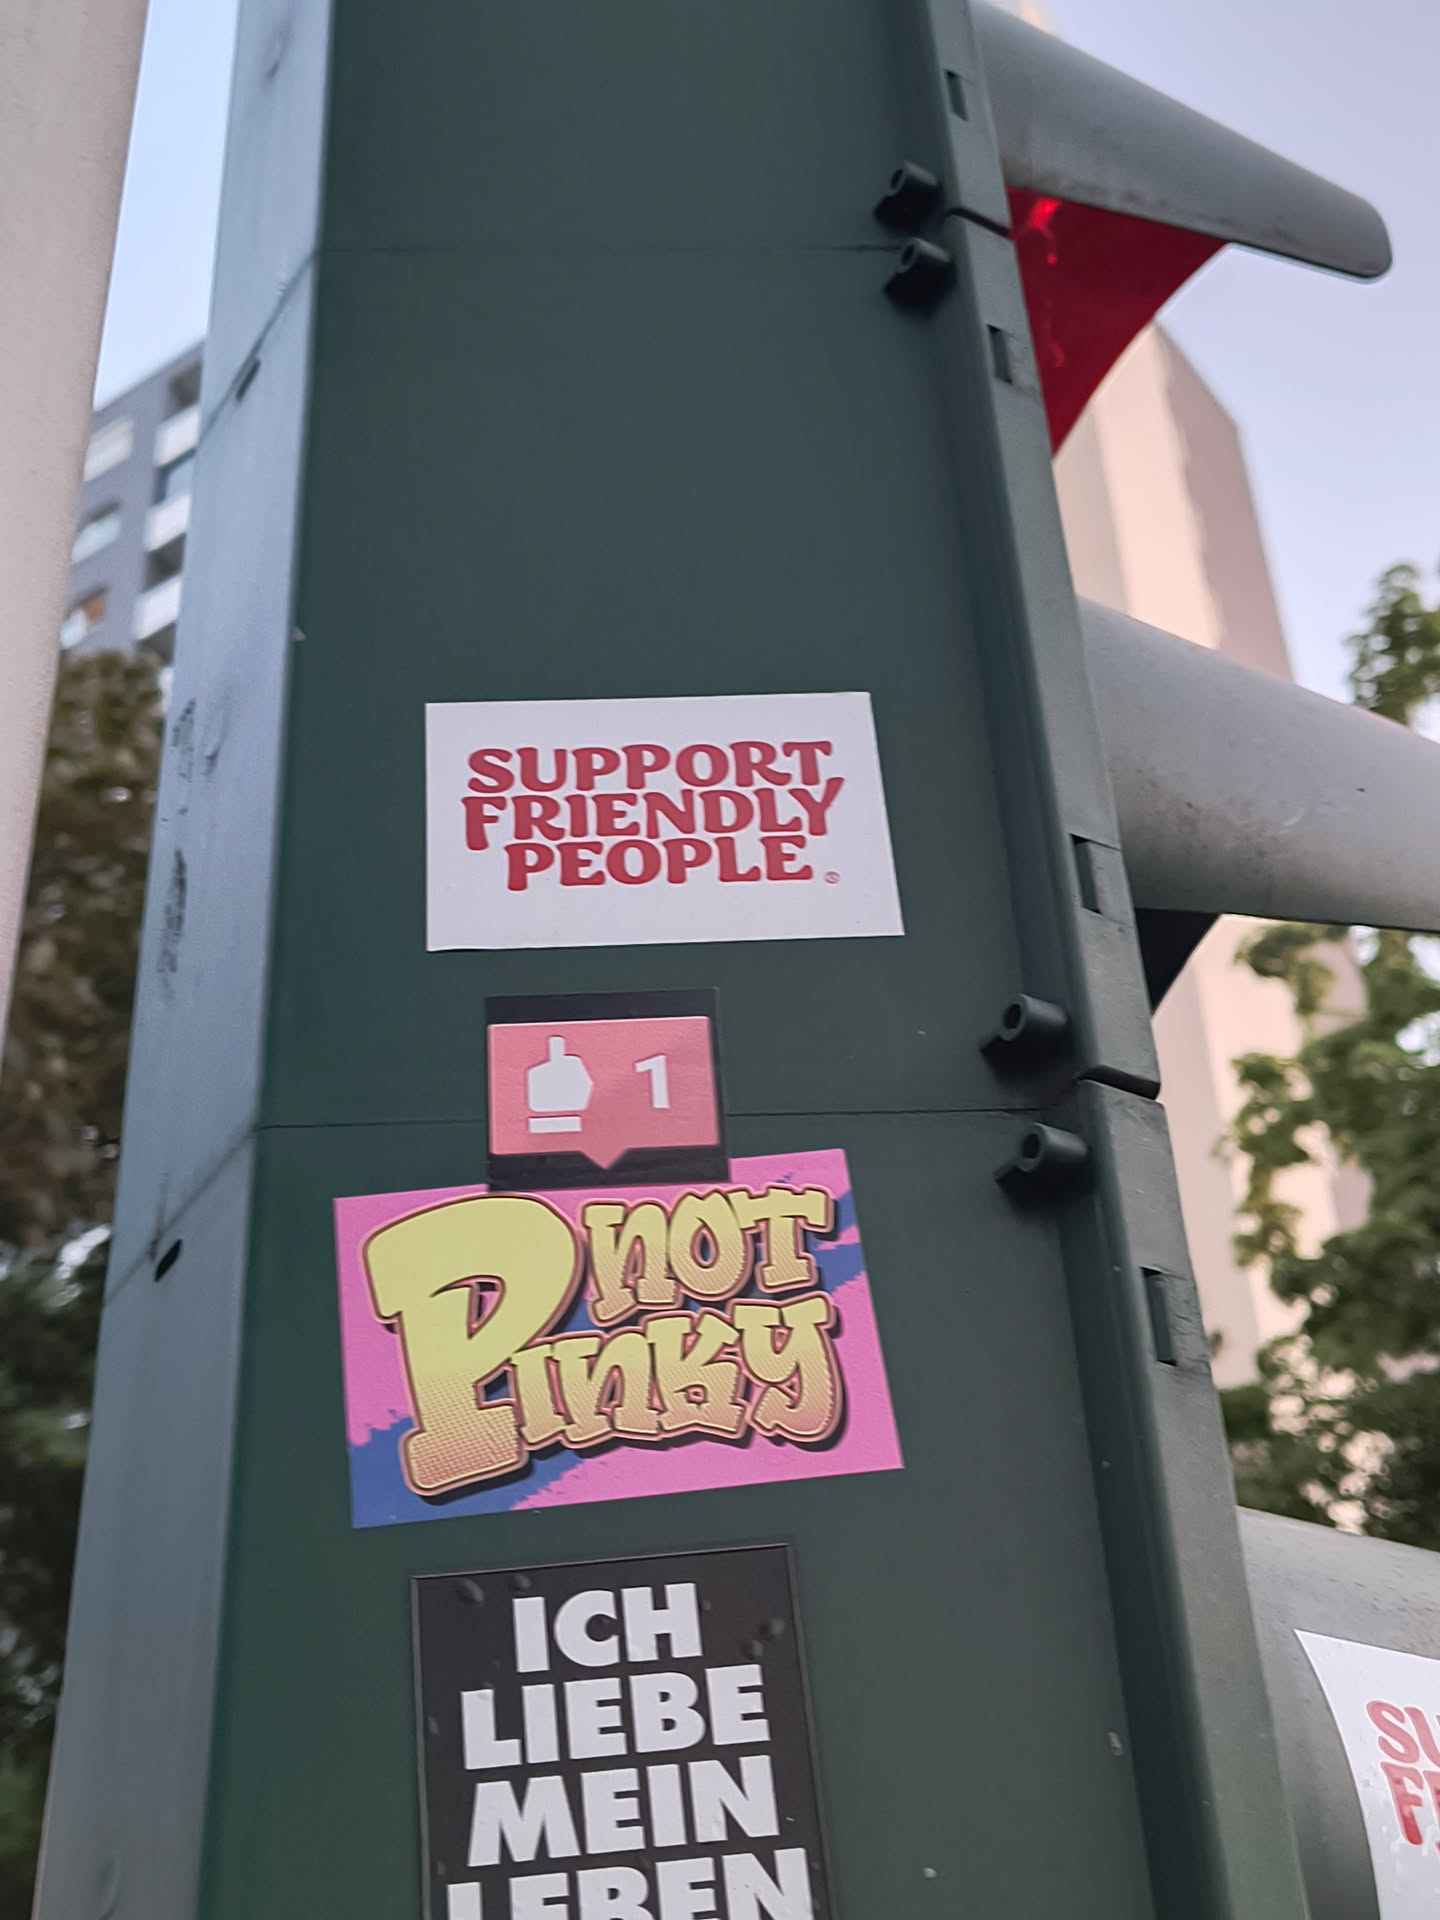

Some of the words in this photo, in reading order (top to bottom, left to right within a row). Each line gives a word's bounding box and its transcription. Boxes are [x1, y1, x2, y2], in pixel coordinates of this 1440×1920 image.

[468, 741, 832, 794] SUPPORT
[462, 777, 845, 851] FRIENDLY
[504, 835, 814, 891] PEOPLE
[634, 1054, 670, 1109] 1
[513, 1583, 703, 1673] ICH
[461, 1664, 771, 1770] LIEBE
[467, 1755, 780, 1867] MEIN
